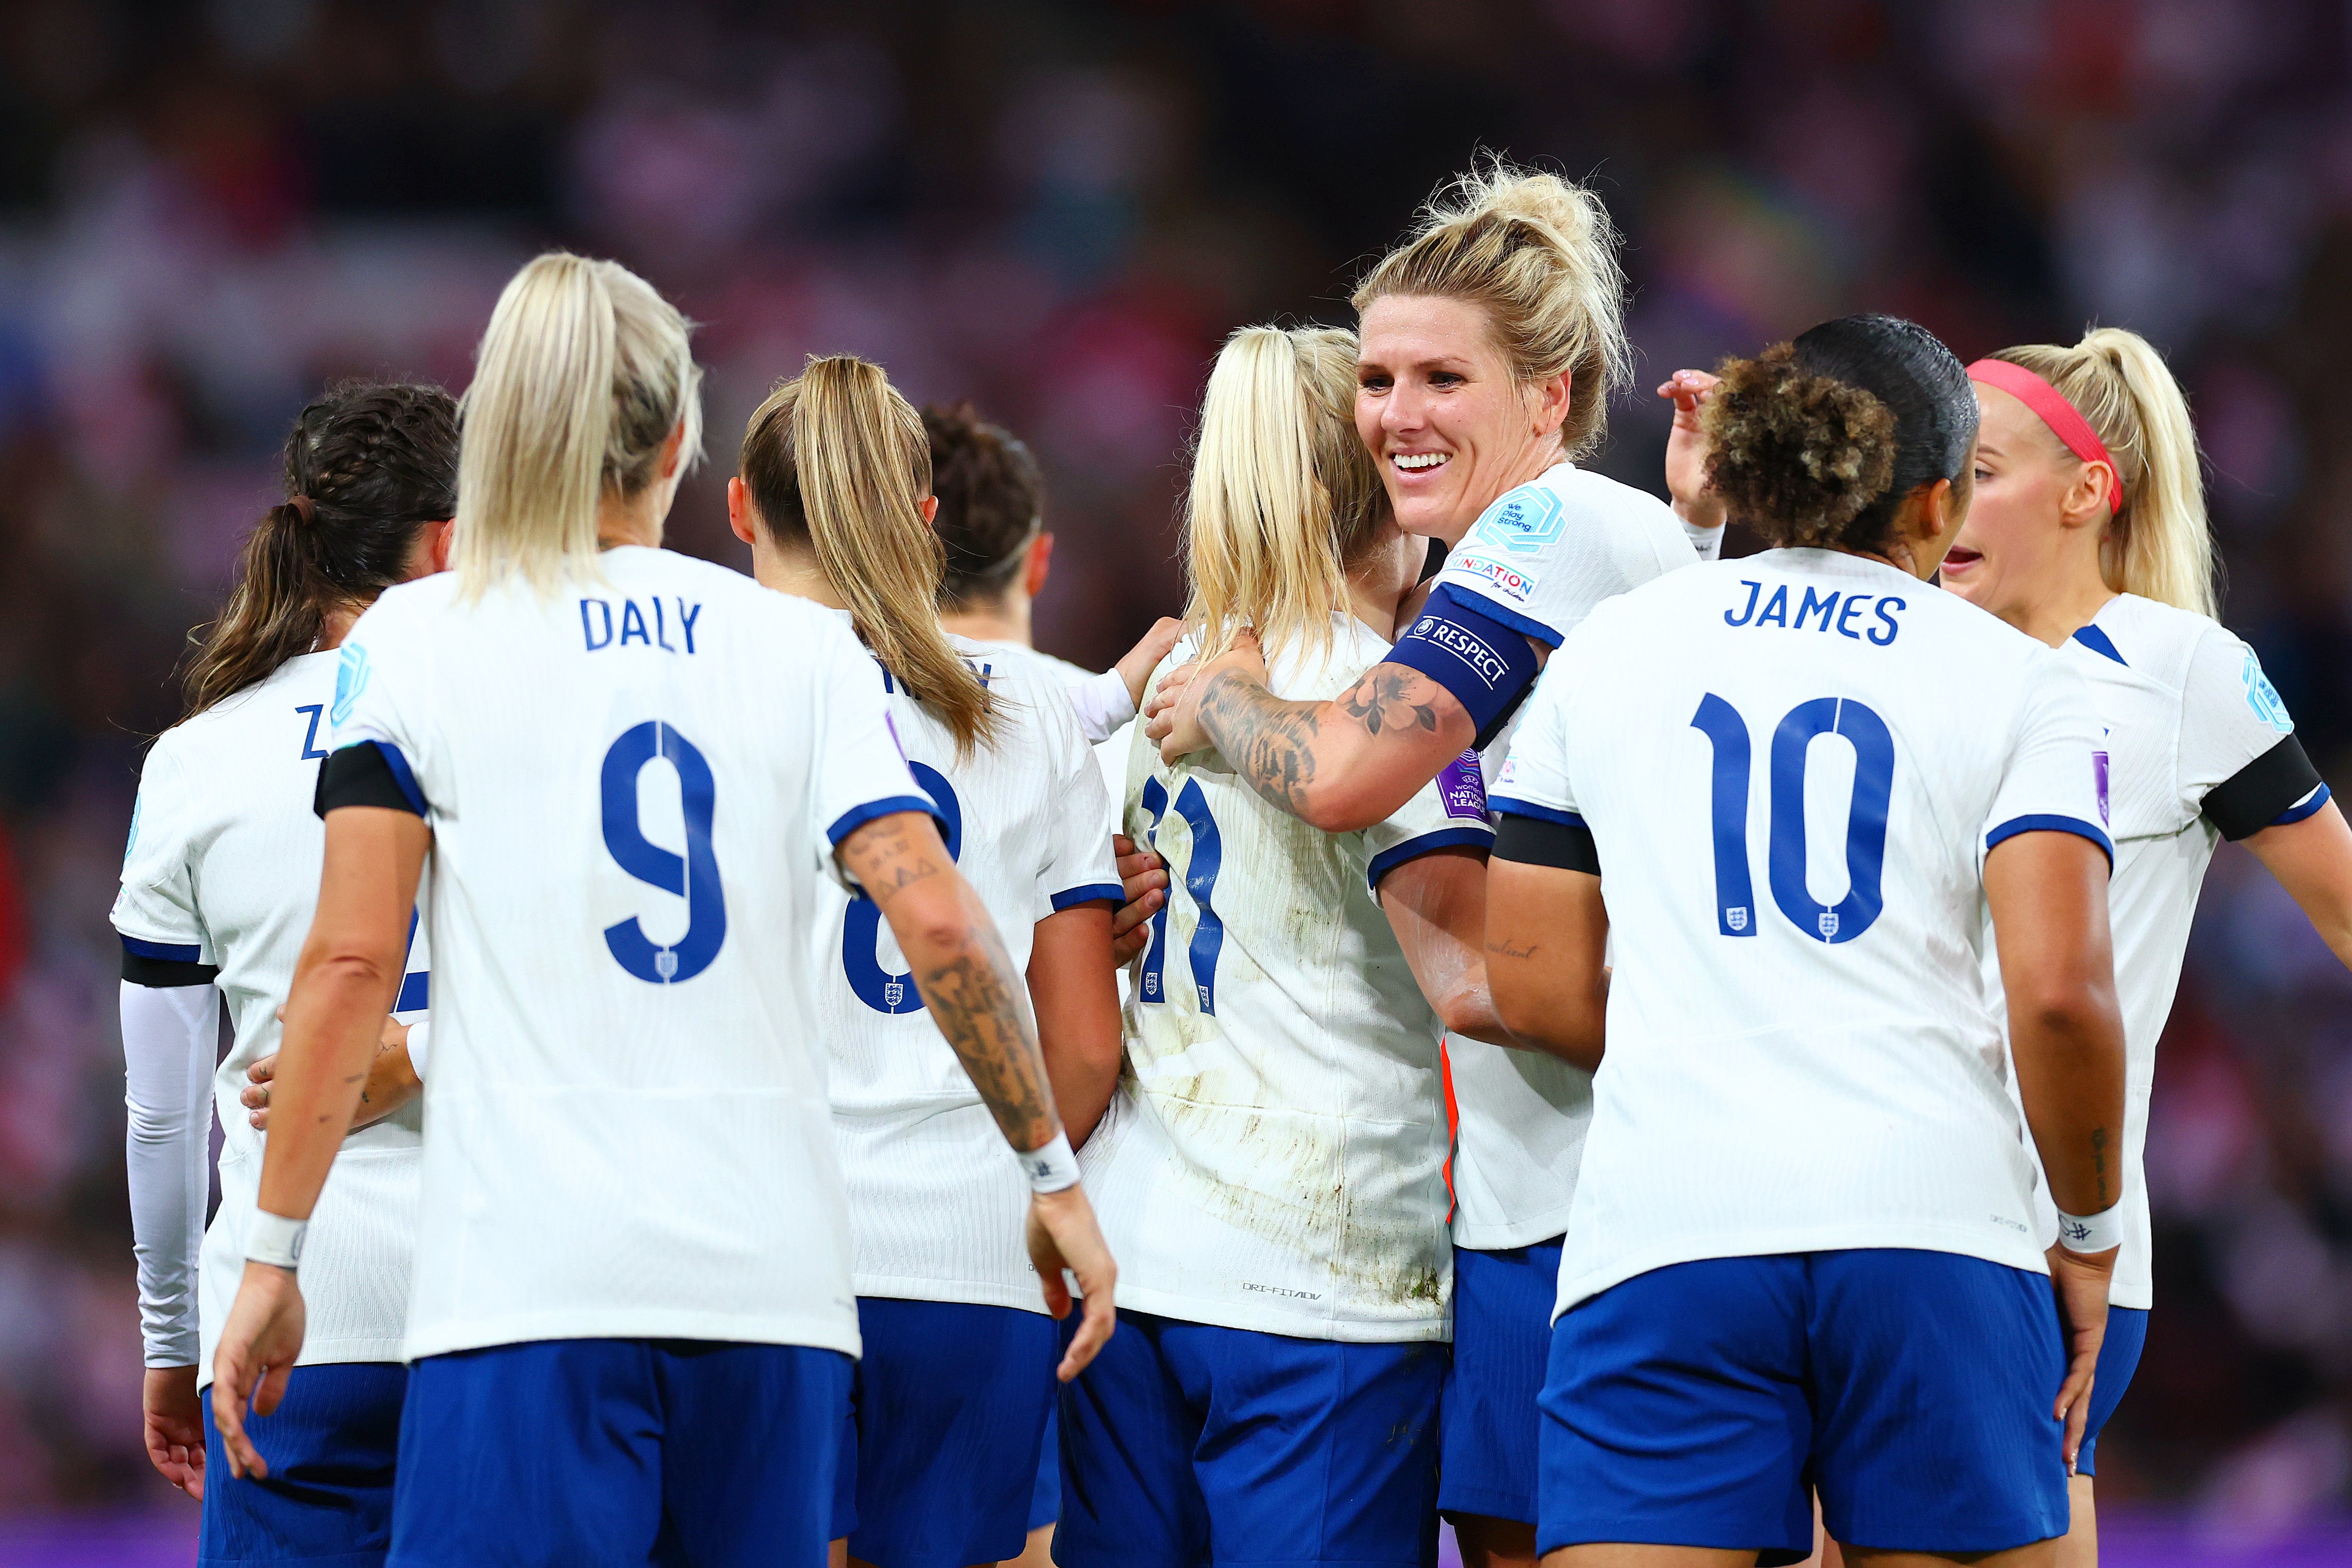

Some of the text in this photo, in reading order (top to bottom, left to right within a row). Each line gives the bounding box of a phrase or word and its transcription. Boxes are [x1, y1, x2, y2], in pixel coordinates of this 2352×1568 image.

[579, 596, 702, 655] DALY
[1503, 587, 1525, 603] children
[1724, 580, 1907, 646] JAMES
[1432, 625, 1505, 682] RESPECT
[1463, 776, 1478, 786] UEFA
[1690, 692, 1895, 945] 10
[601, 720, 726, 984] 9
[1140, 774, 1223, 1018] 11
